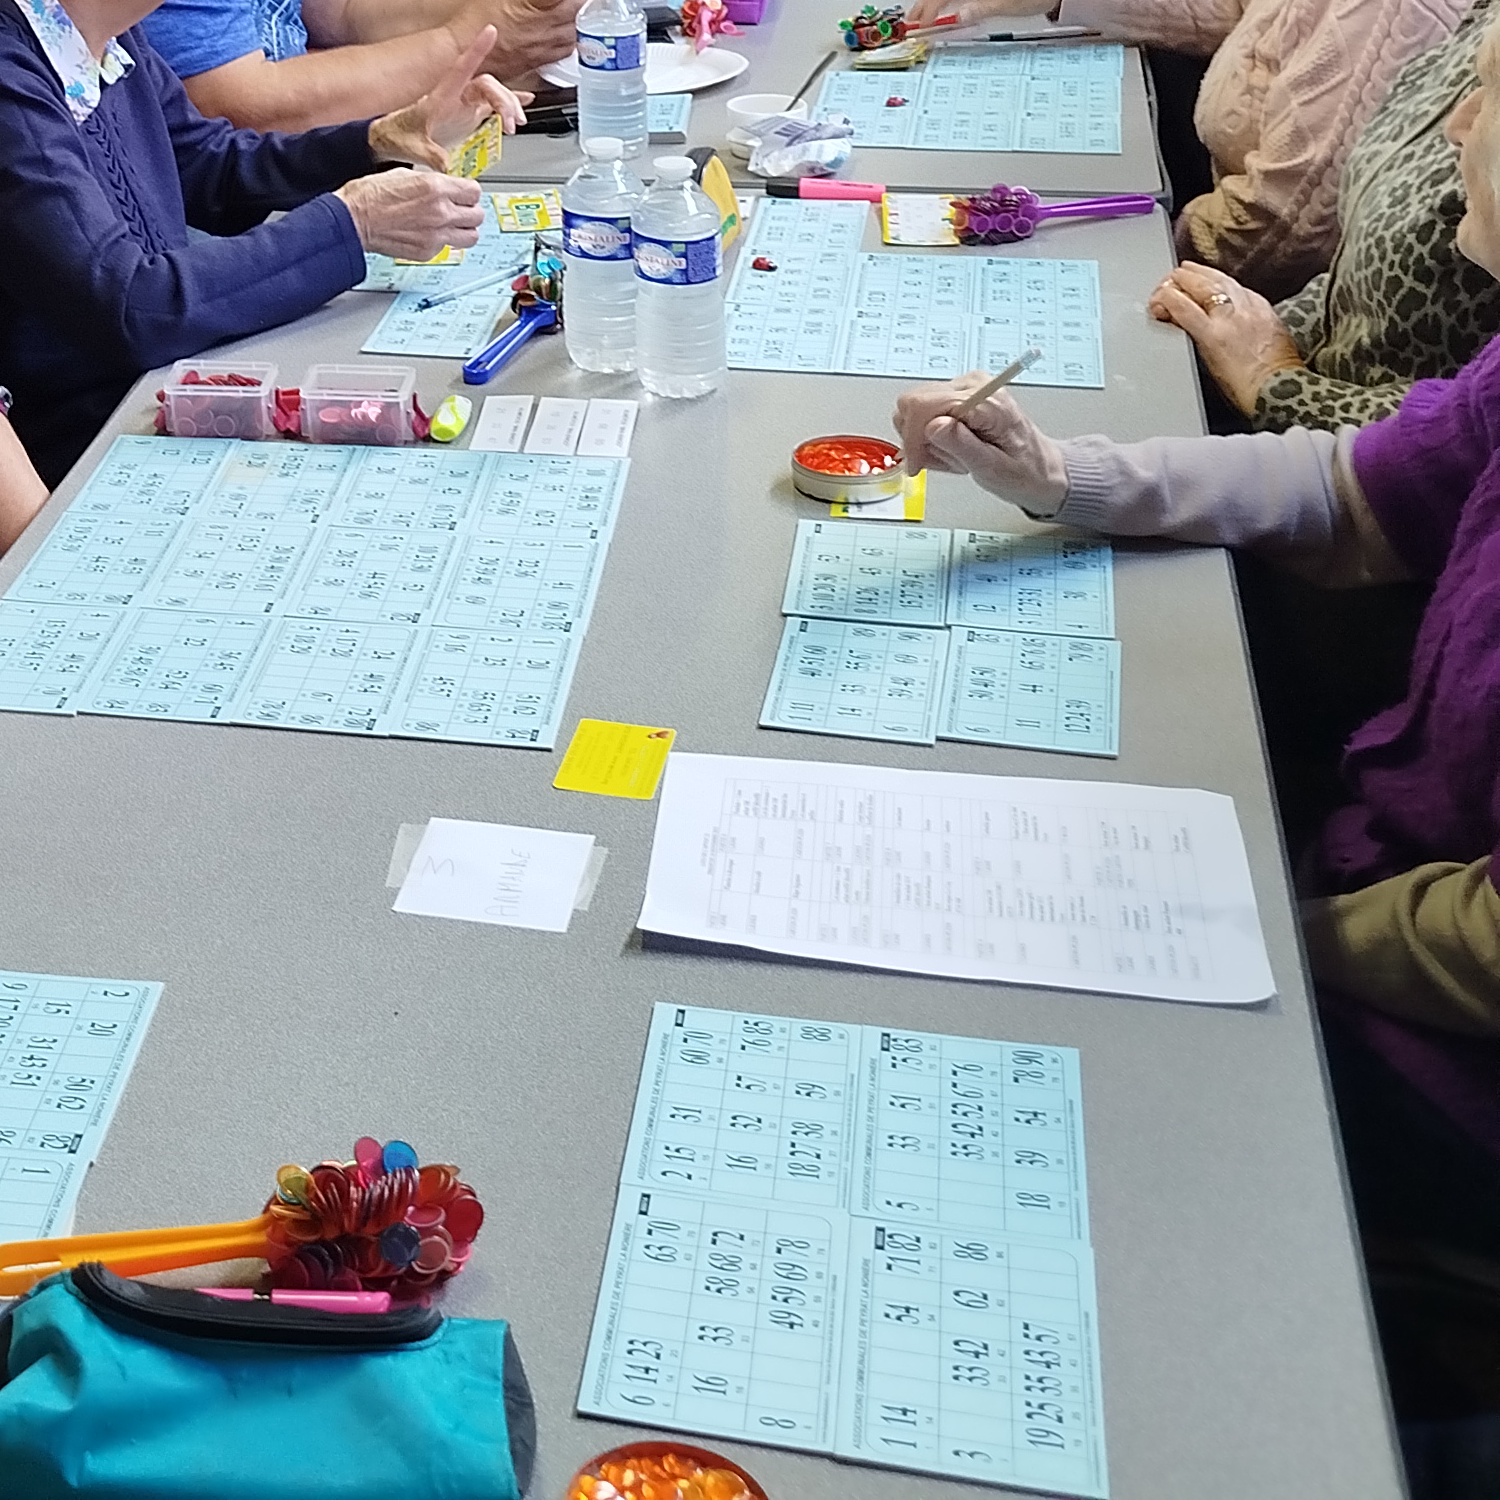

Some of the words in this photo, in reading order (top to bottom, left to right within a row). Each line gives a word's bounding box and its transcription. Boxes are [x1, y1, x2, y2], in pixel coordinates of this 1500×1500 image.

[1, 982, 29, 991] 9
[102, 988, 131, 999] 2
[42, 1001, 73, 1015] 15
[86, 1021, 118, 1037] 20
[742, 1019, 774, 1036] 85
[799, 1025, 833, 1042] 88
[26, 1035, 58, 1051] 31
[682, 1030, 714, 1047] 70
[741, 1037, 773, 1053] 76
[889, 1037, 924, 1054] 83
[18, 1053, 49, 1069] 43
[679, 1048, 711, 1066] 60
[890, 1055, 924, 1071] 75
[1011, 1050, 1045, 1067] 90
[9, 1071, 42, 1087] 51
[951, 1062, 984, 1079] 76
[1012, 1069, 1046, 1085] 78
[63, 1076, 96, 1092] 50
[734, 1075, 767, 1093] 57
[794, 1082, 827, 1100] 59
[951, 1083, 985, 1099] 67
[55, 1095, 88, 1111] 62
[890, 1094, 922, 1111] 51
[950, 1102, 985, 1120] 52
[668, 1106, 703, 1123] 31
[729, 1114, 763, 1132] 32
[1013, 1109, 1047, 1127] 54
[790, 1121, 825, 1138] 38
[950, 1122, 984, 1140] 42
[38, 1132, 70, 1150] 82
[886, 1134, 921, 1151] 33
[663, 1144, 697, 1163] 15
[788, 1142, 822, 1161] 27
[950, 1142, 985, 1161] 35
[1014, 1150, 1049, 1168] 39
[21, 1164, 50, 1176] 1
[724, 1153, 759, 1172] 16
[787, 1162, 821, 1180] 18
[660, 1170, 693, 1181] 2
[885, 1199, 919, 1211] 5
[1015, 1192, 1051, 1210] 18
[647, 1220, 681, 1240] 70
[711, 1230, 745, 1249] 72
[775, 1238, 811, 1257] 78
[885, 1232, 922, 1253] 82
[642, 1243, 678, 1263] 63
[952, 1240, 989, 1262] 86
[707, 1252, 743, 1273] 68
[773, 1261, 808, 1282] 69
[886, 1255, 921, 1275] 71
[704, 1275, 740, 1297] 58
[770, 1285, 807, 1307] 59
[952, 1289, 990, 1310] 62
[768, 1309, 804, 1331] 49
[883, 1303, 920, 1325] 54
[697, 1325, 734, 1346] 33
[1022, 1323, 1060, 1345] 57
[625, 1338, 664, 1361] 23
[952, 1339, 990, 1360] 42
[1022, 1349, 1061, 1370] 43
[622, 1363, 660, 1385] 14
[952, 1364, 990, 1387] 33
[691, 1374, 729, 1396] 16
[1024, 1373, 1063, 1397] 35
[619, 1393, 656, 1406] 6
[880, 1404, 917, 1427] 14
[1024, 1400, 1064, 1425] 25
[758, 1416, 797, 1430] 8
[880, 1437, 917, 1449] 1
[1025, 1427, 1065, 1450] 19
[951, 1449, 991, 1460] 3
